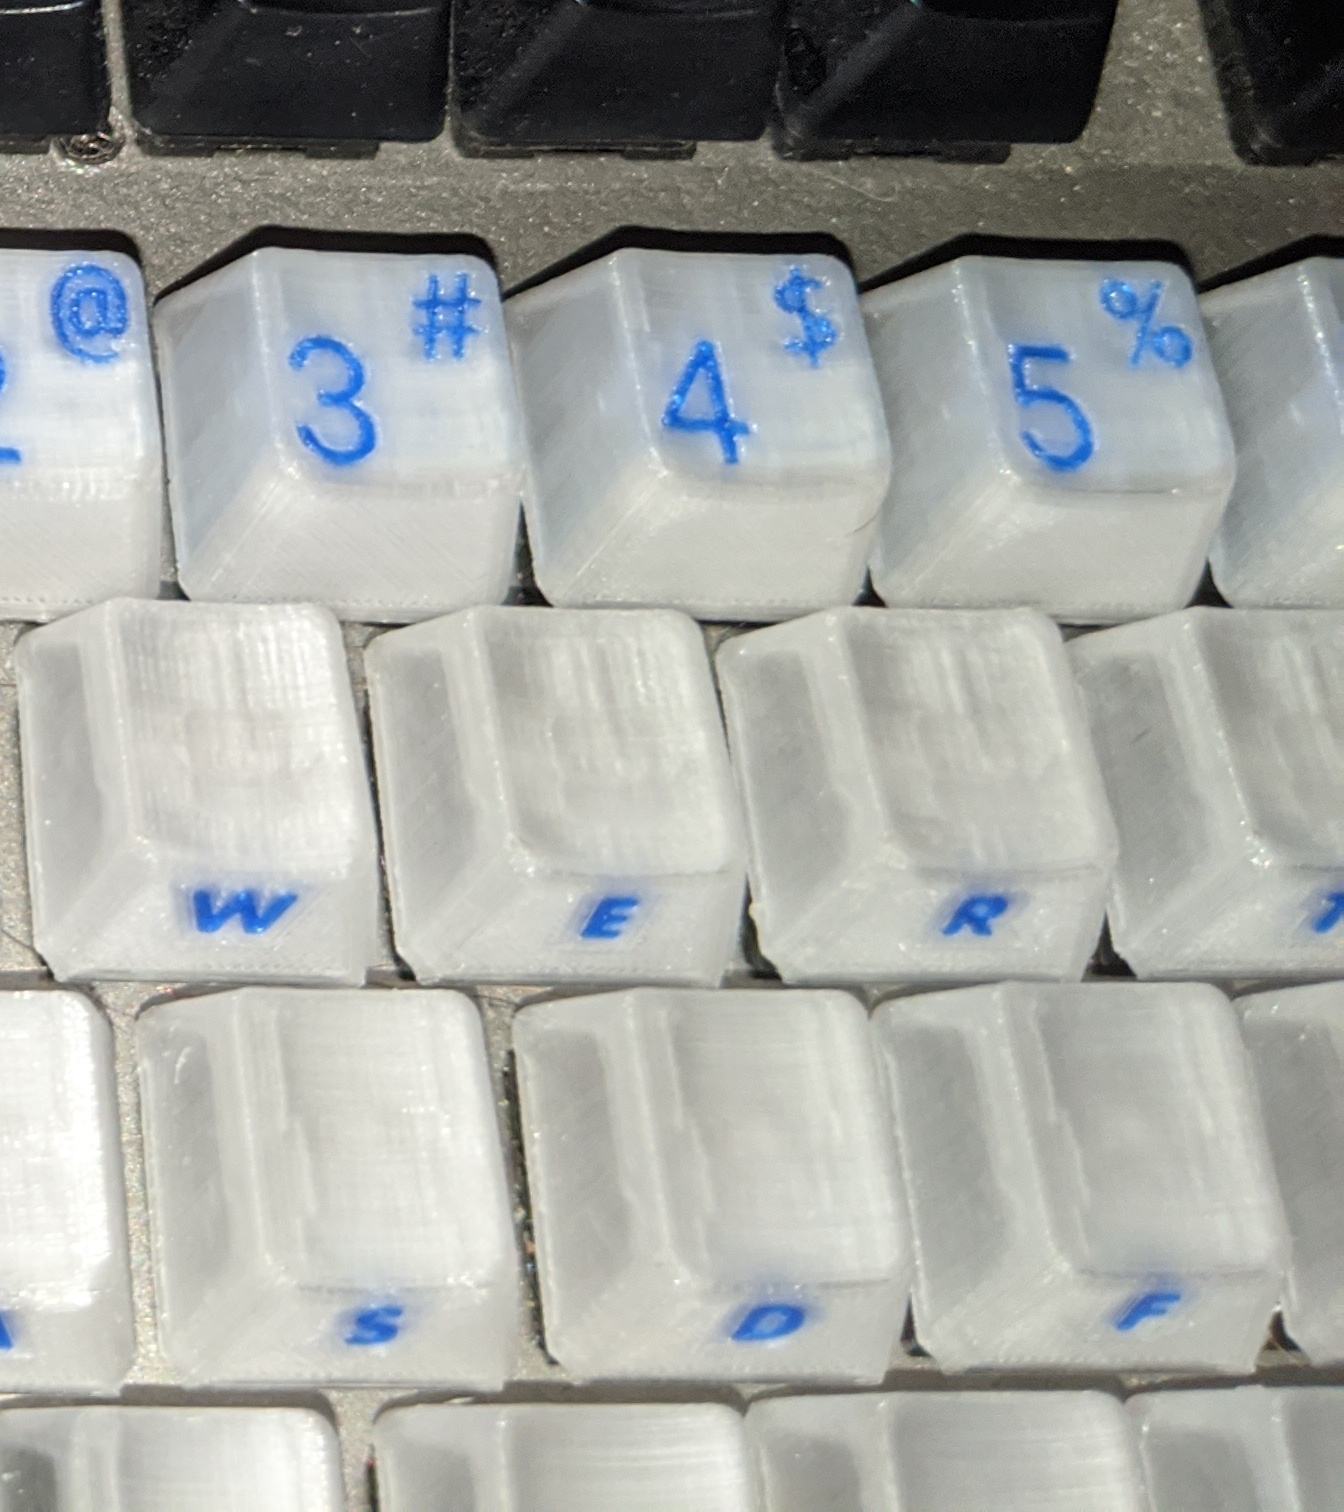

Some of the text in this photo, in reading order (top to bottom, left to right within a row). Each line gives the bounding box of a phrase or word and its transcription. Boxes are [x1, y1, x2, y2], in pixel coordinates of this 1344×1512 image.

[50, 263, 131, 365] @
[412, 273, 483, 361] #
[773, 267, 838, 367] $
[1099, 279, 1194, 370] %
[288, 334, 379, 468] 3
[663, 339, 751, 465] 4
[1009, 342, 1096, 474] 5
[192, 889, 298, 935] W
[581, 894, 640, 940] E
[942, 894, 1010, 938] R
[347, 1304, 404, 1346] S
[731, 1302, 807, 1342] D
[1115, 1290, 1183, 1332] F
